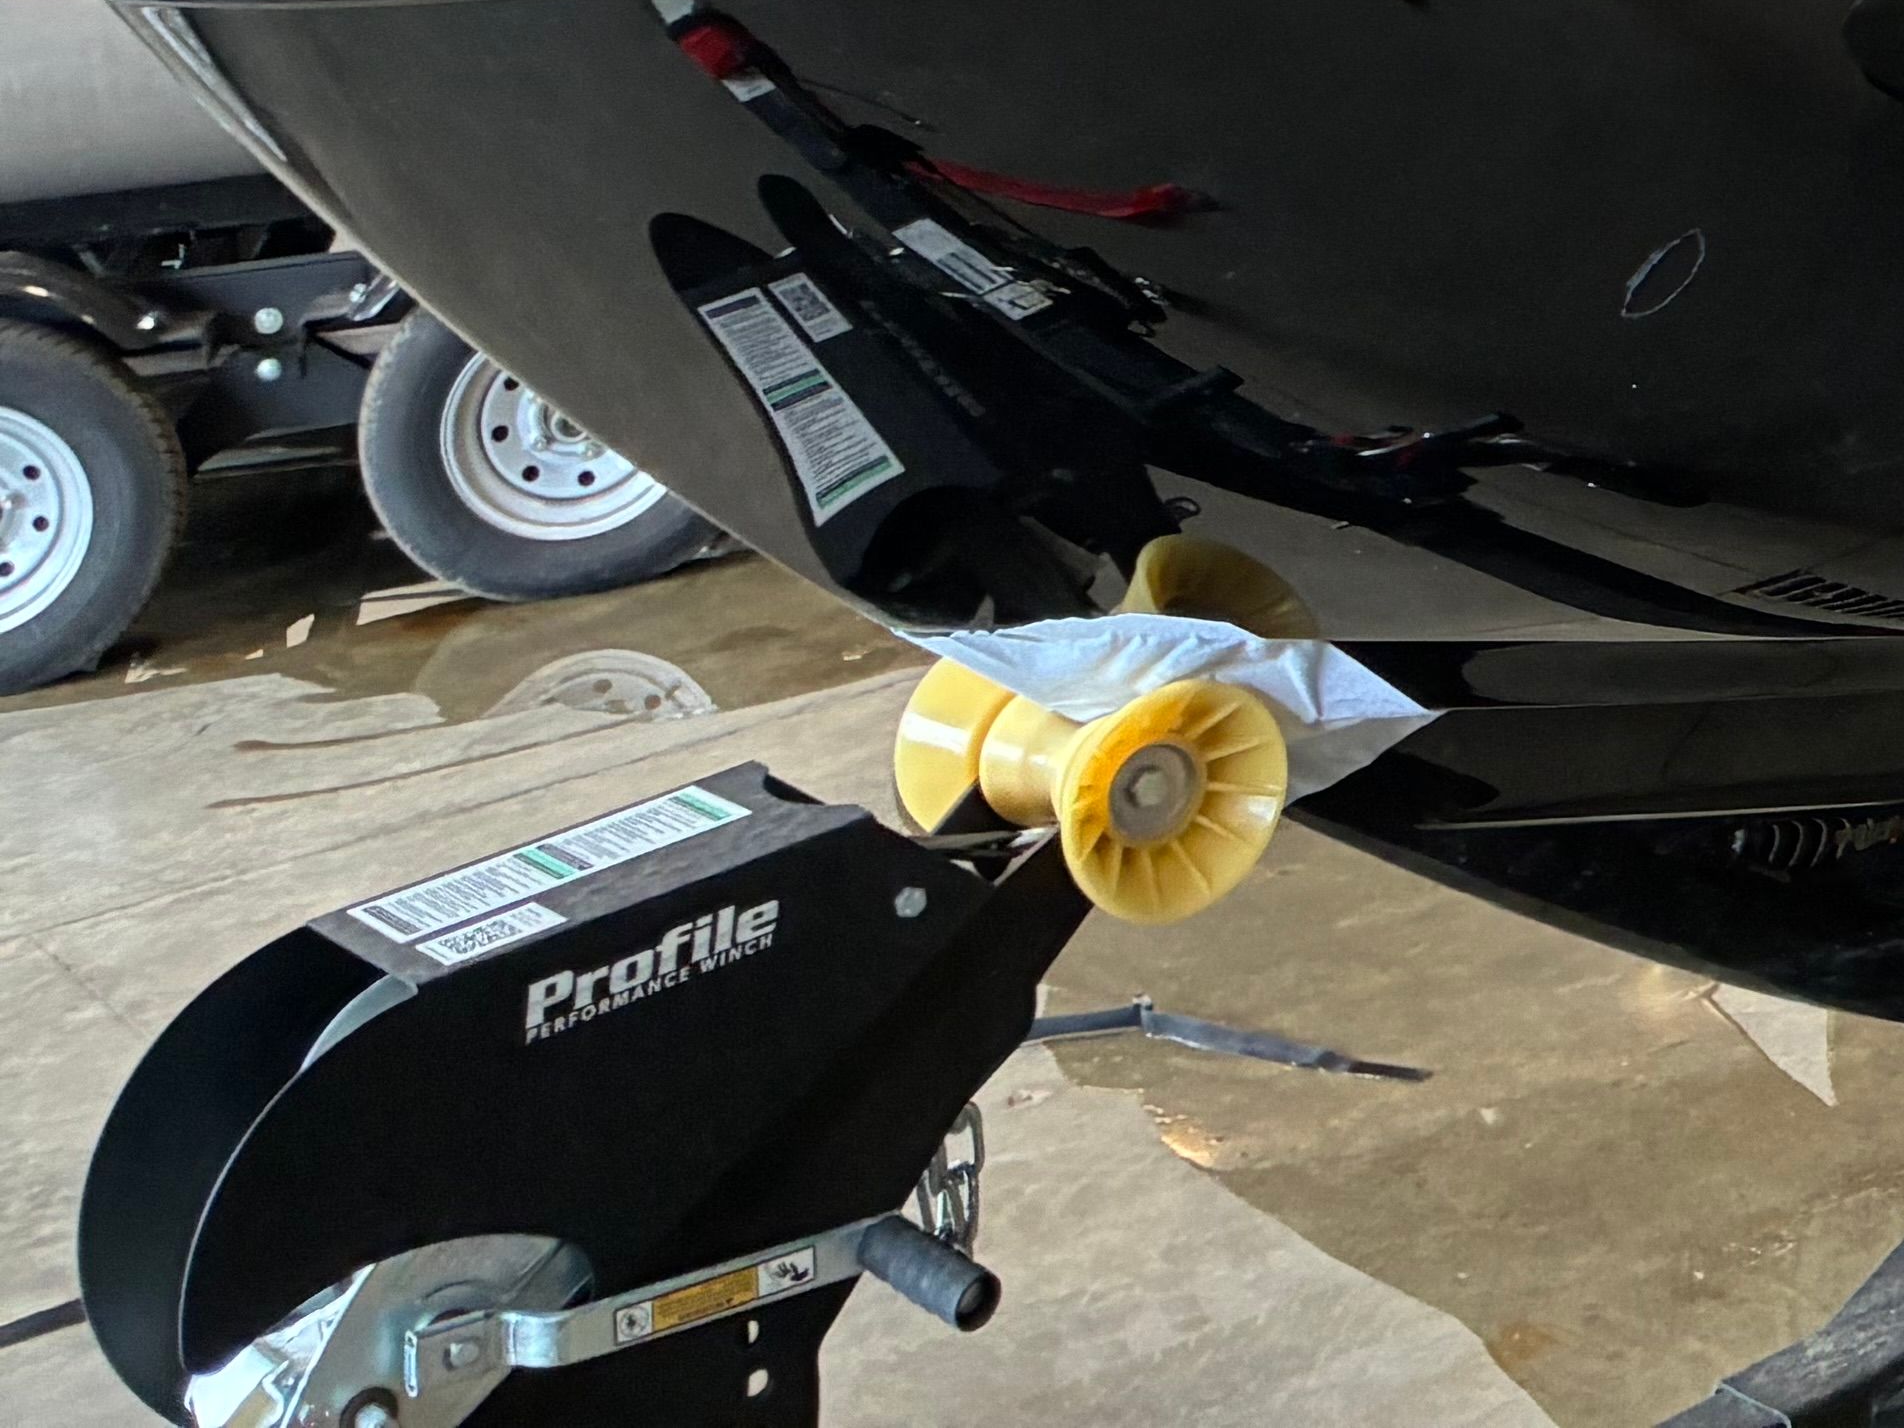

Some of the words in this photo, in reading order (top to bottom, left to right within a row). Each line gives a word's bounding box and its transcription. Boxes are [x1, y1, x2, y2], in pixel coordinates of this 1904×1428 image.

[525, 899, 780, 1029] Profile
[525, 966, 691, 1046] PERFORMANCE
[700, 932, 774, 976] WINCH
